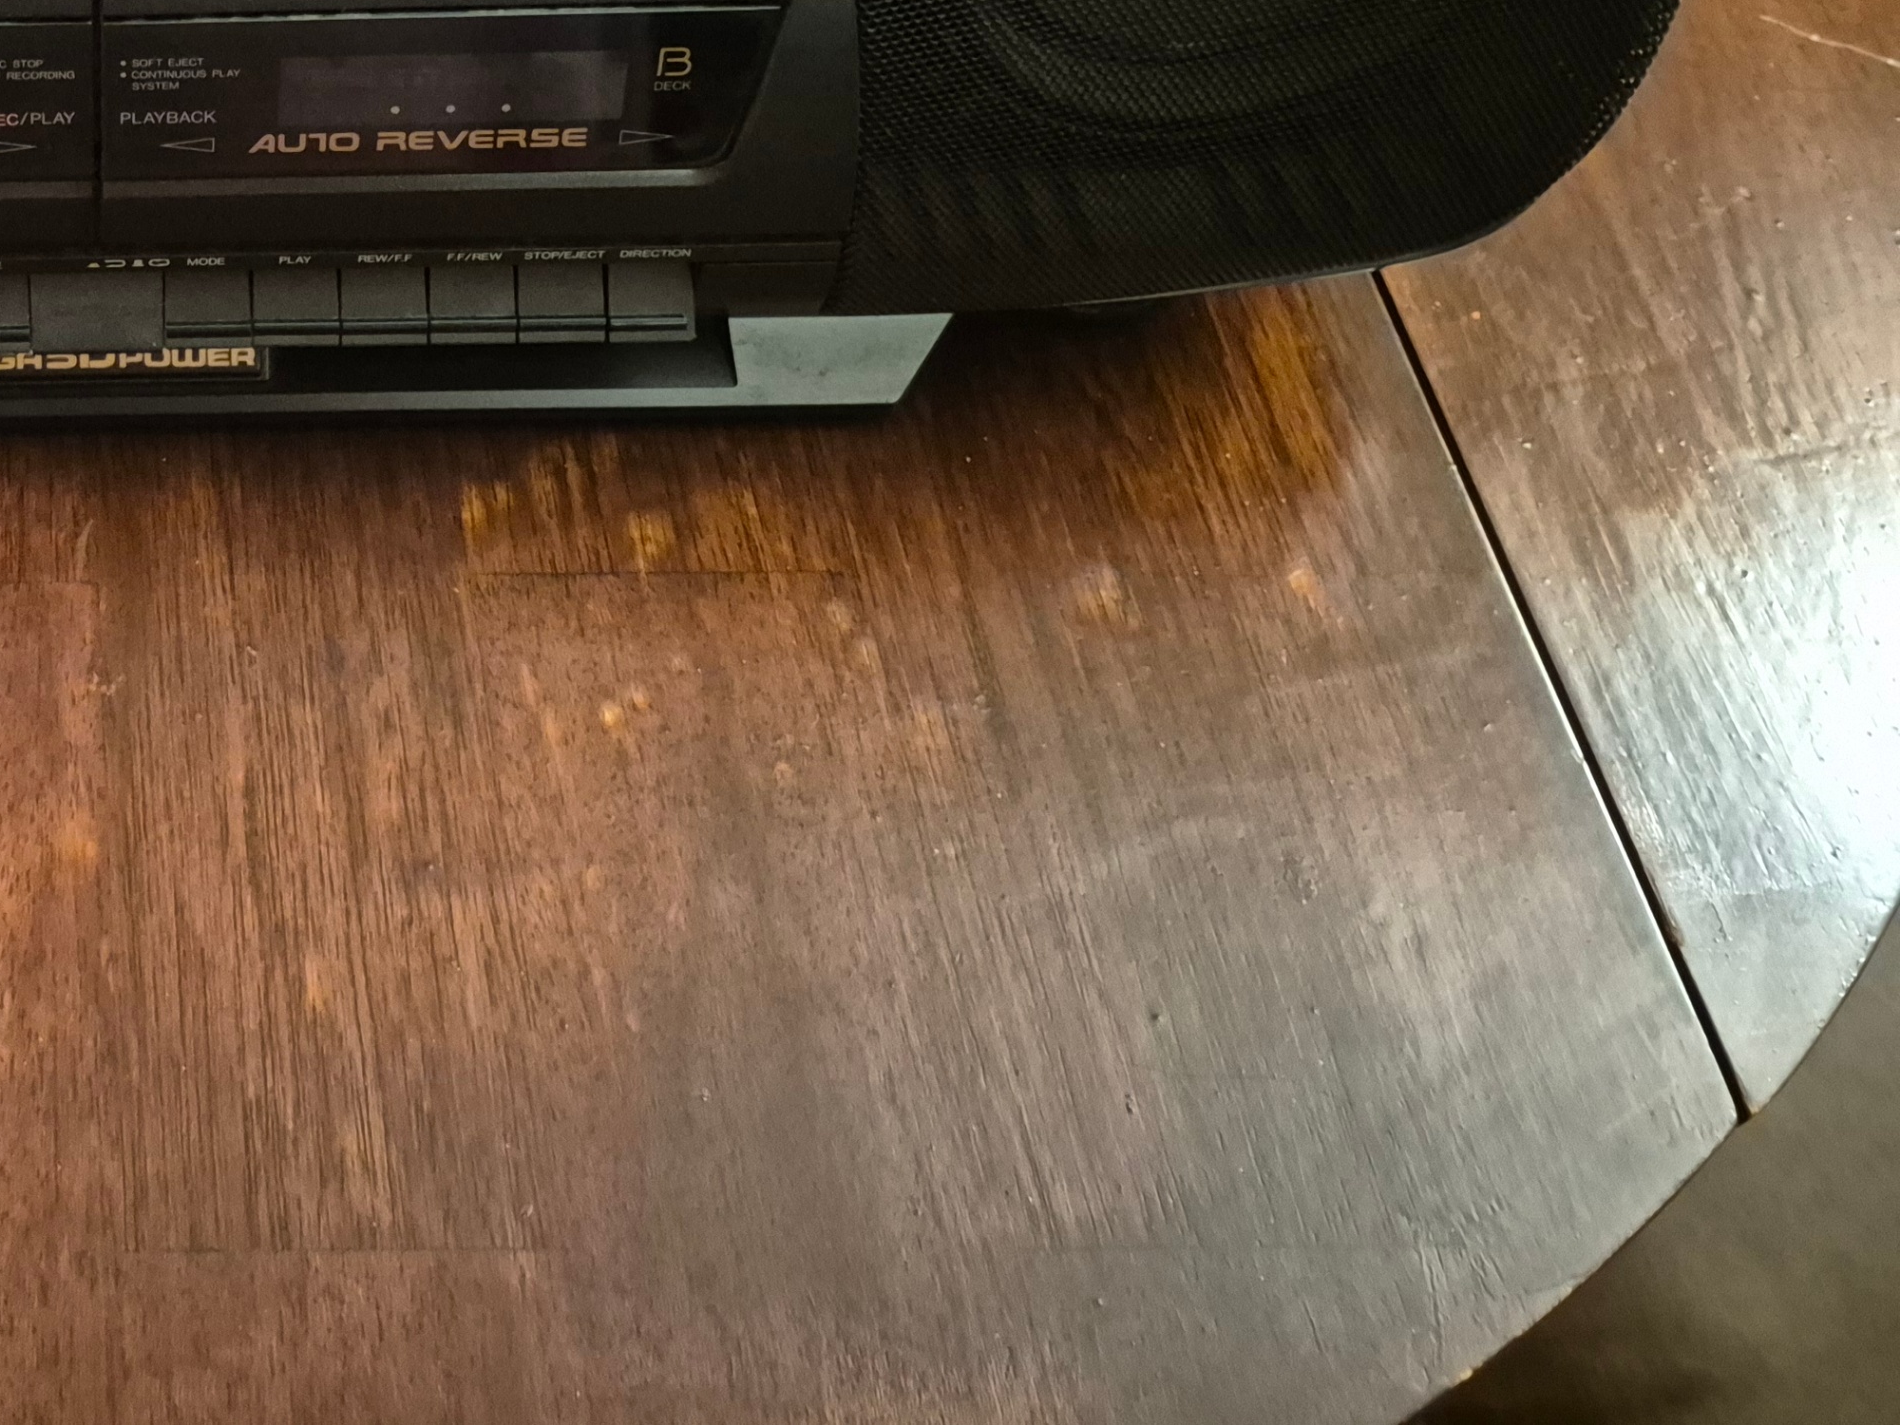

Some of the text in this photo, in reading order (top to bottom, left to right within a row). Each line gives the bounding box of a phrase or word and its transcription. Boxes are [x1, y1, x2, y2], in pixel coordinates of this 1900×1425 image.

[12, 59, 44, 69] STOP
[132, 57, 205, 68] SOFT EJECT
[6, 70, 76, 80] RECORDING
[131, 69, 241, 80] CONTINUOUS PLAY
[132, 81, 180, 91] SYSTEM
[653, 80, 692, 92] DECK
[120, 110, 218, 125] PLAYBACK
[247, 127, 589, 154] AUTO REVERSE
[524, 250, 606, 261] STOP/EJECT
[619, 248, 693, 259] DIRECTION
[186, 257, 226, 267] MODE
[278, 256, 312, 265] PLAY
[118, 347, 257, 370] POWER
